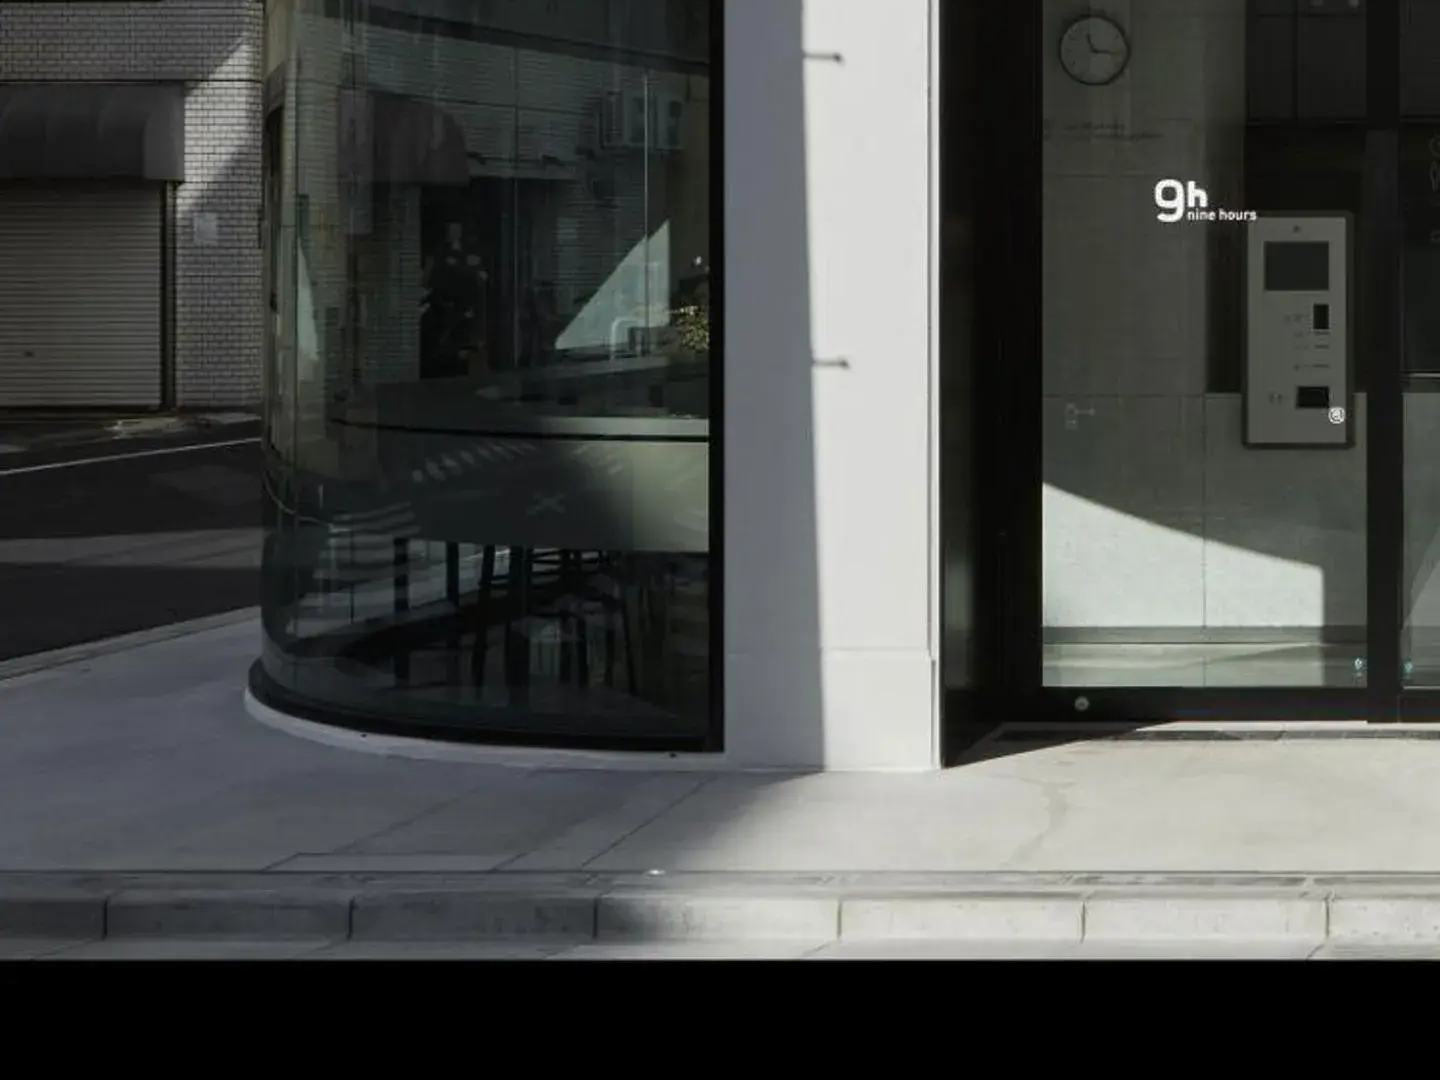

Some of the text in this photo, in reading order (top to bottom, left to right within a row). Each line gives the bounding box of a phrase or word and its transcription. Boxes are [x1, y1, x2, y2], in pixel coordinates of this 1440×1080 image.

[1154, 178, 1209, 223] 9h
[1187, 207, 1257, 221] nine hours
